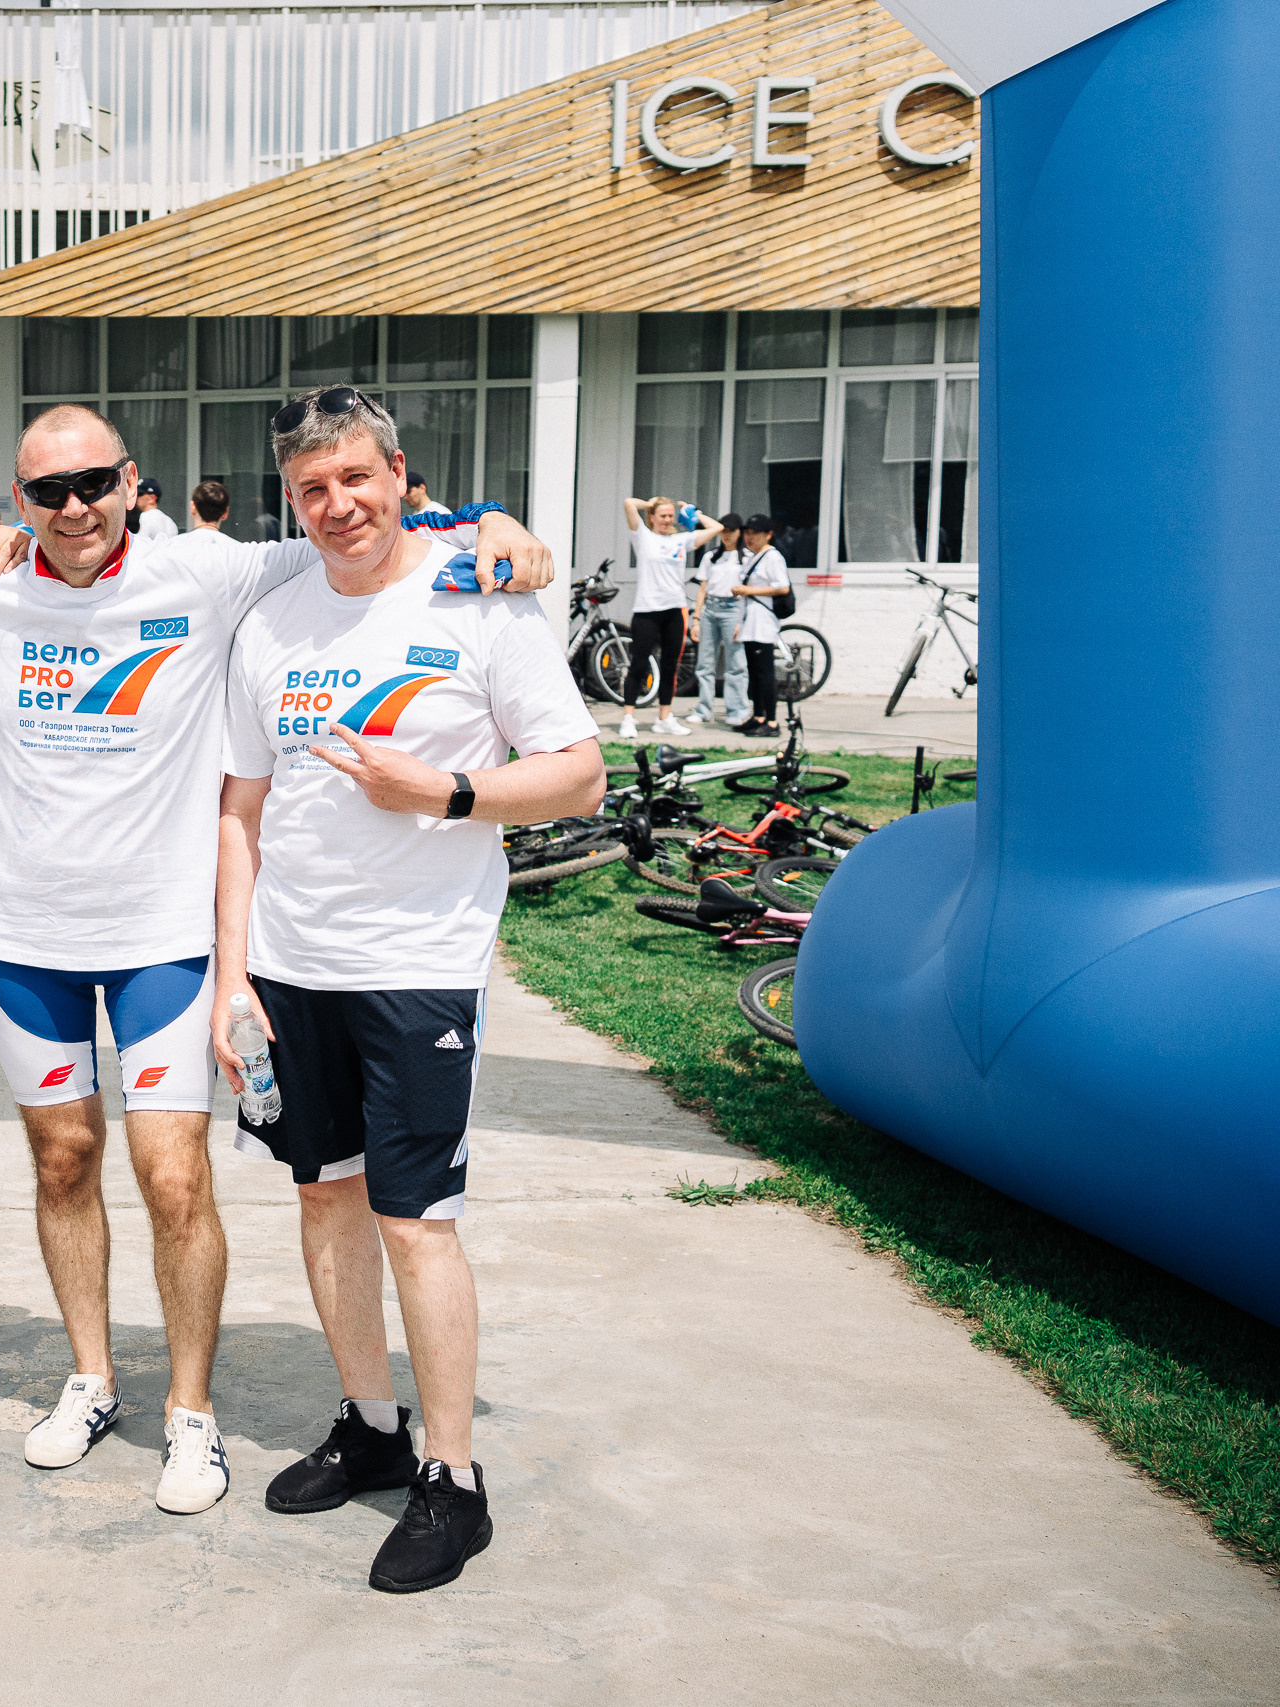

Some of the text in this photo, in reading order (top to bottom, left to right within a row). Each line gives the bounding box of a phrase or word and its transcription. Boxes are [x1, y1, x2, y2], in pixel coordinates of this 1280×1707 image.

[611, 75, 817, 169] ICE
[143, 620, 186, 638] 2022
[409, 649, 457, 667] 2022
[20, 665, 74, 689] PRO
[280, 692, 333, 712] PRO
[19, 719, 35, 728] ООО
[75, 724, 109, 733] трансгаз
[19, 739, 51, 749] Первичная
[52, 742, 95, 752] профсоюзная
[43, 734, 88, 743] ХАБАРОВСКОЕ
[434, 1040, 464, 1049] adidas
